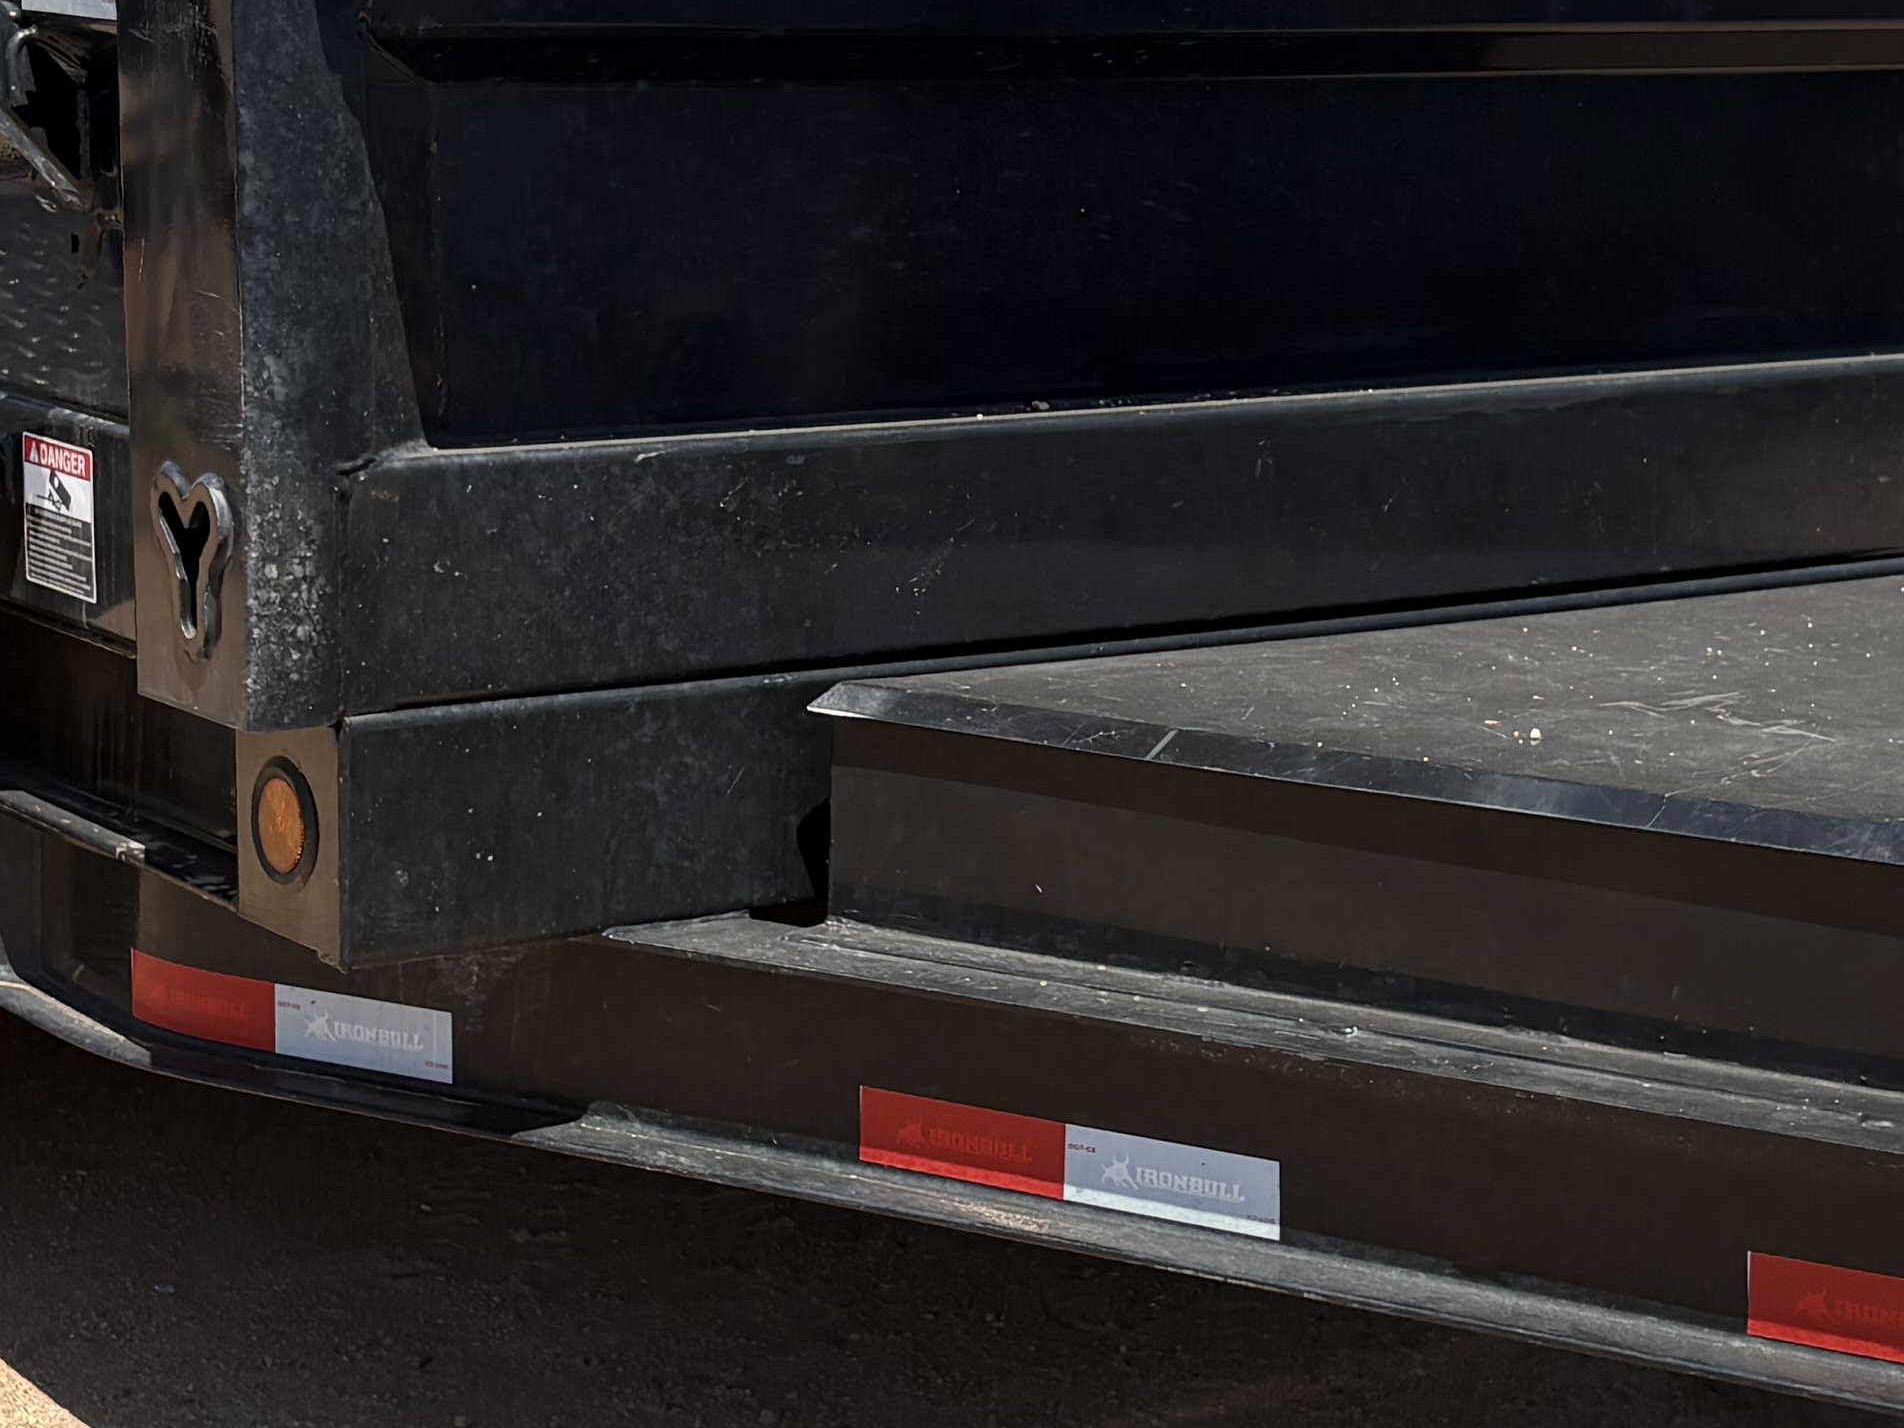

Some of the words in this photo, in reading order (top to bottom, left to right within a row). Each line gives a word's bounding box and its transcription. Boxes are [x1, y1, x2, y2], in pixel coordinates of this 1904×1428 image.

[40, 442, 87, 478] DANGER
[334, 1020, 424, 1052] IRONBULL
[928, 1127, 1033, 1163] IRONBULL
[1135, 1166, 1246, 1203] IRONBULL
